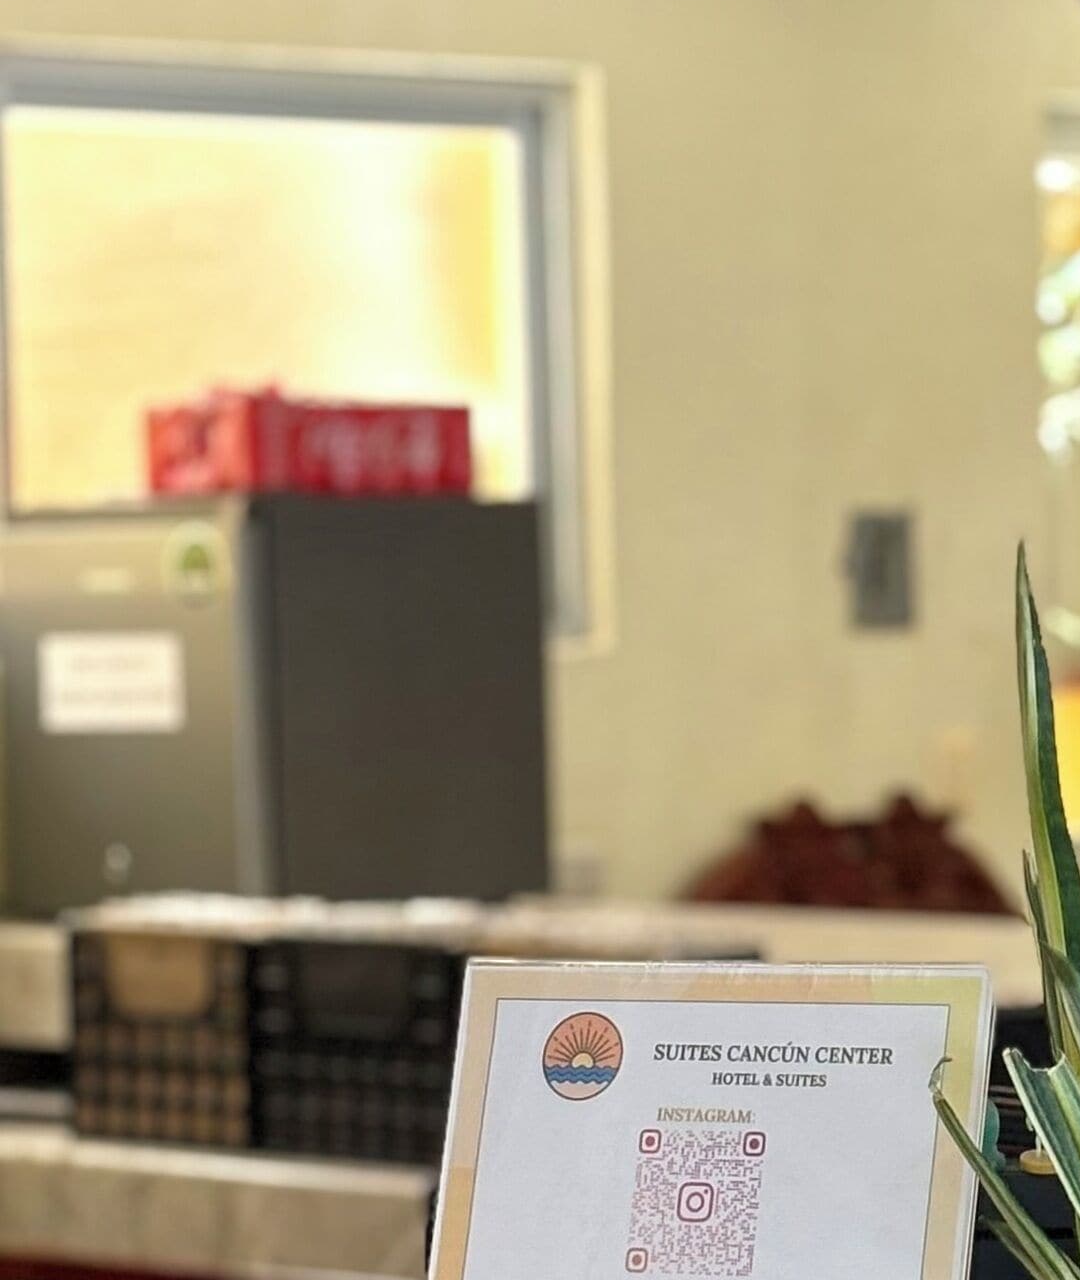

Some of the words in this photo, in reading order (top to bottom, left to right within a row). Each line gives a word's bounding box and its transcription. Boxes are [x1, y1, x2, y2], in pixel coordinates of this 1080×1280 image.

[653, 1043, 722, 1062] SUITES
[727, 1041, 810, 1063] CANCÚN
[815, 1046, 893, 1065] CENTER
[712, 1072, 759, 1086] HOTEL
[763, 1073, 772, 1086] &
[775, 1074, 827, 1087] SUITES
[656, 1107, 756, 1124] INSTAGRAM:
